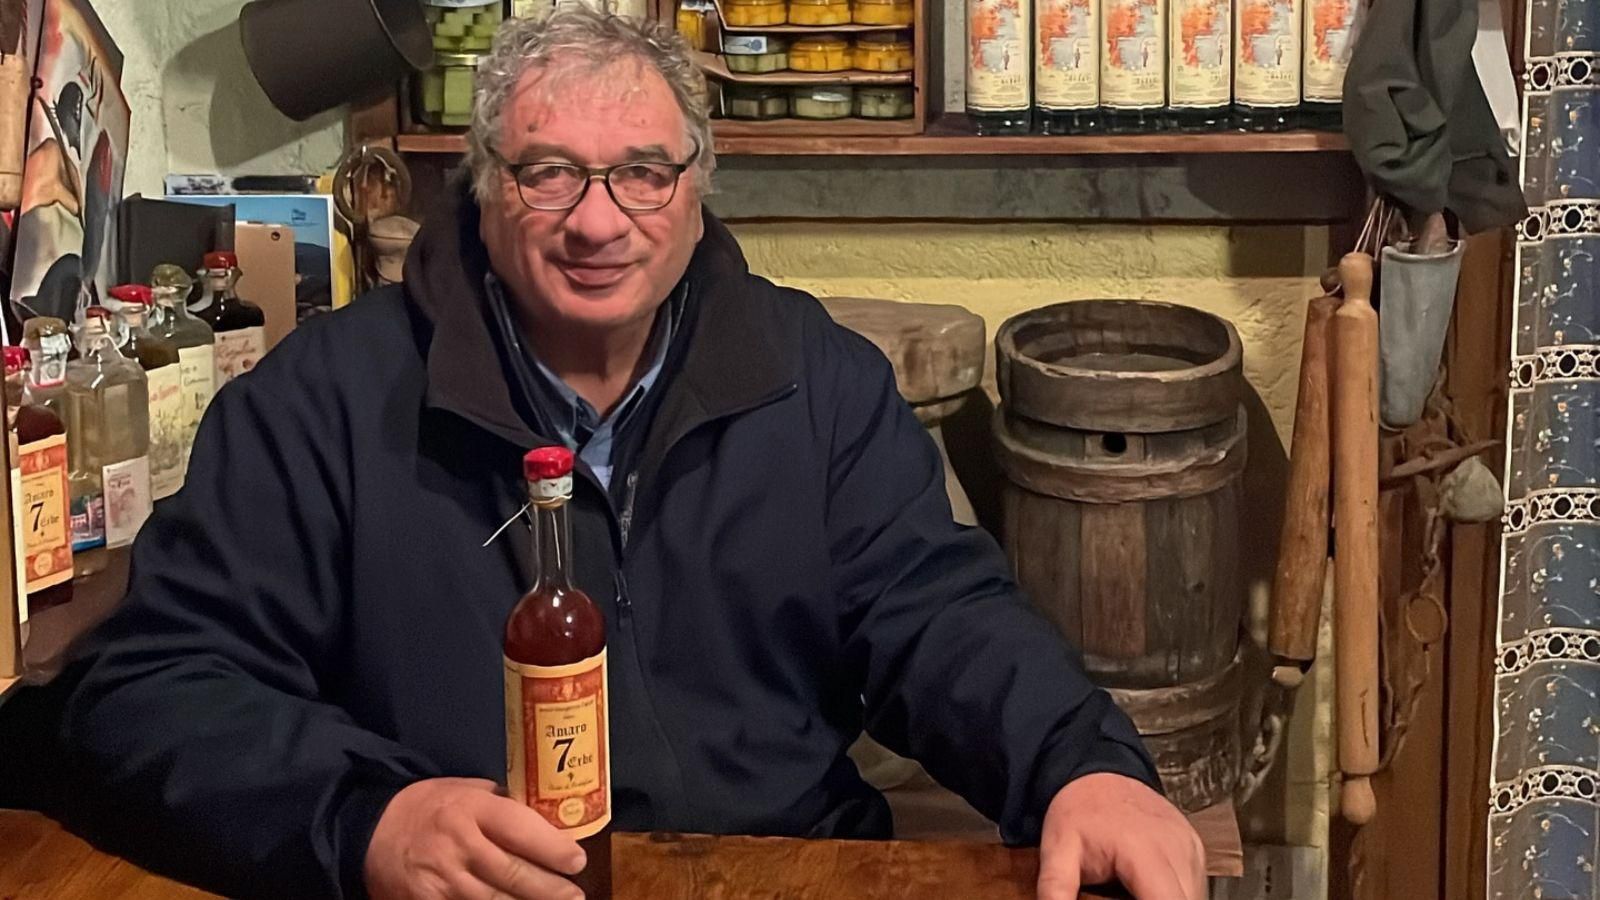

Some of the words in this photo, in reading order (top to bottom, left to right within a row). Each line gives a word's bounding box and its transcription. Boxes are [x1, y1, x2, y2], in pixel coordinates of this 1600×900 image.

[30, 502, 45, 533] 7
[545, 723, 587, 738] Amaro
[552, 738, 576, 773] 7
[567, 754, 593, 769] Erbe
